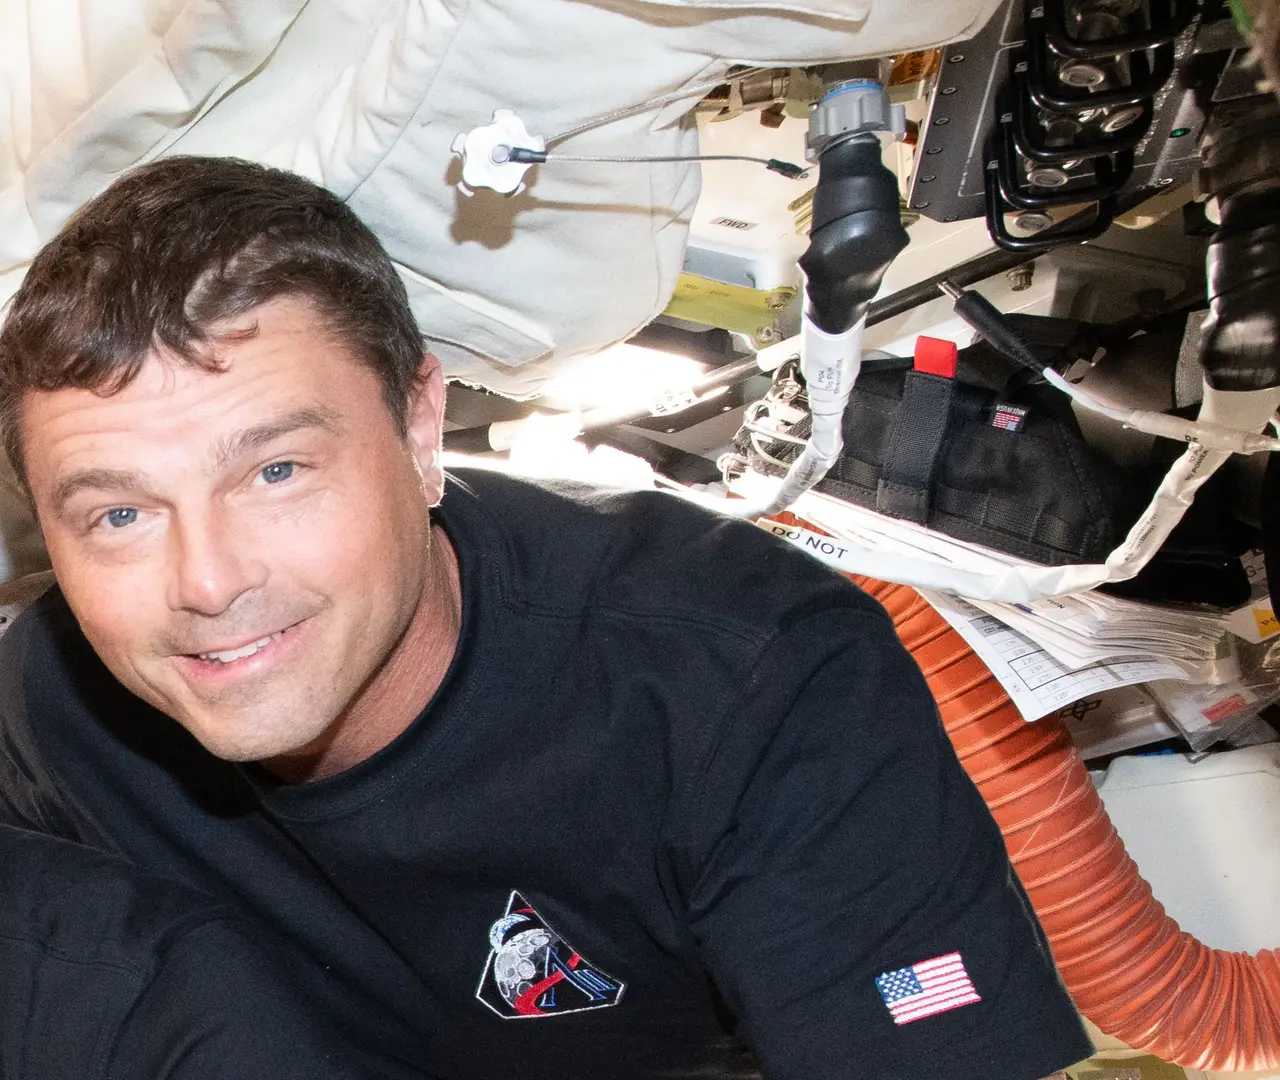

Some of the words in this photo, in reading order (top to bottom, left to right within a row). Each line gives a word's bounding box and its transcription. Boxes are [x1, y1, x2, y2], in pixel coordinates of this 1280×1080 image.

[718, 218, 748, 229] FWD
[771, 526, 801, 540] DO
[805, 536, 849, 559] NOT
